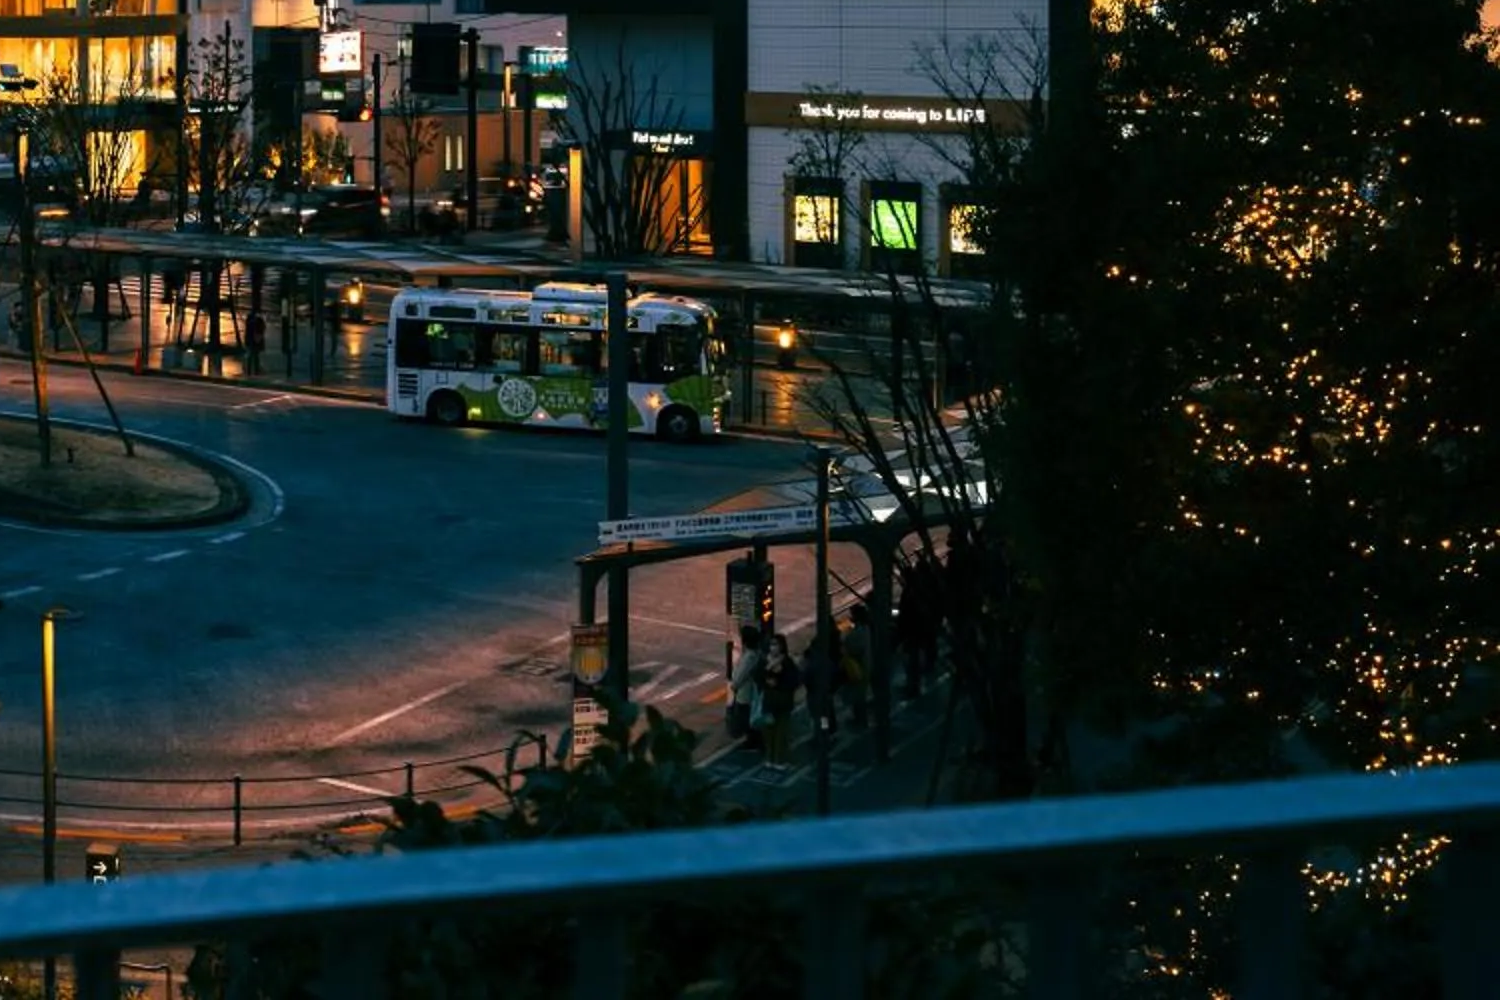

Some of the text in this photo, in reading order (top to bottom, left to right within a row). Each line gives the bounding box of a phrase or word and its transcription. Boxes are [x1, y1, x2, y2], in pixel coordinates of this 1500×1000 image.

[837, 107, 861, 120] you
[862, 105, 880, 119] for
[883, 107, 927, 124] coming
[929, 109, 943, 121] to
